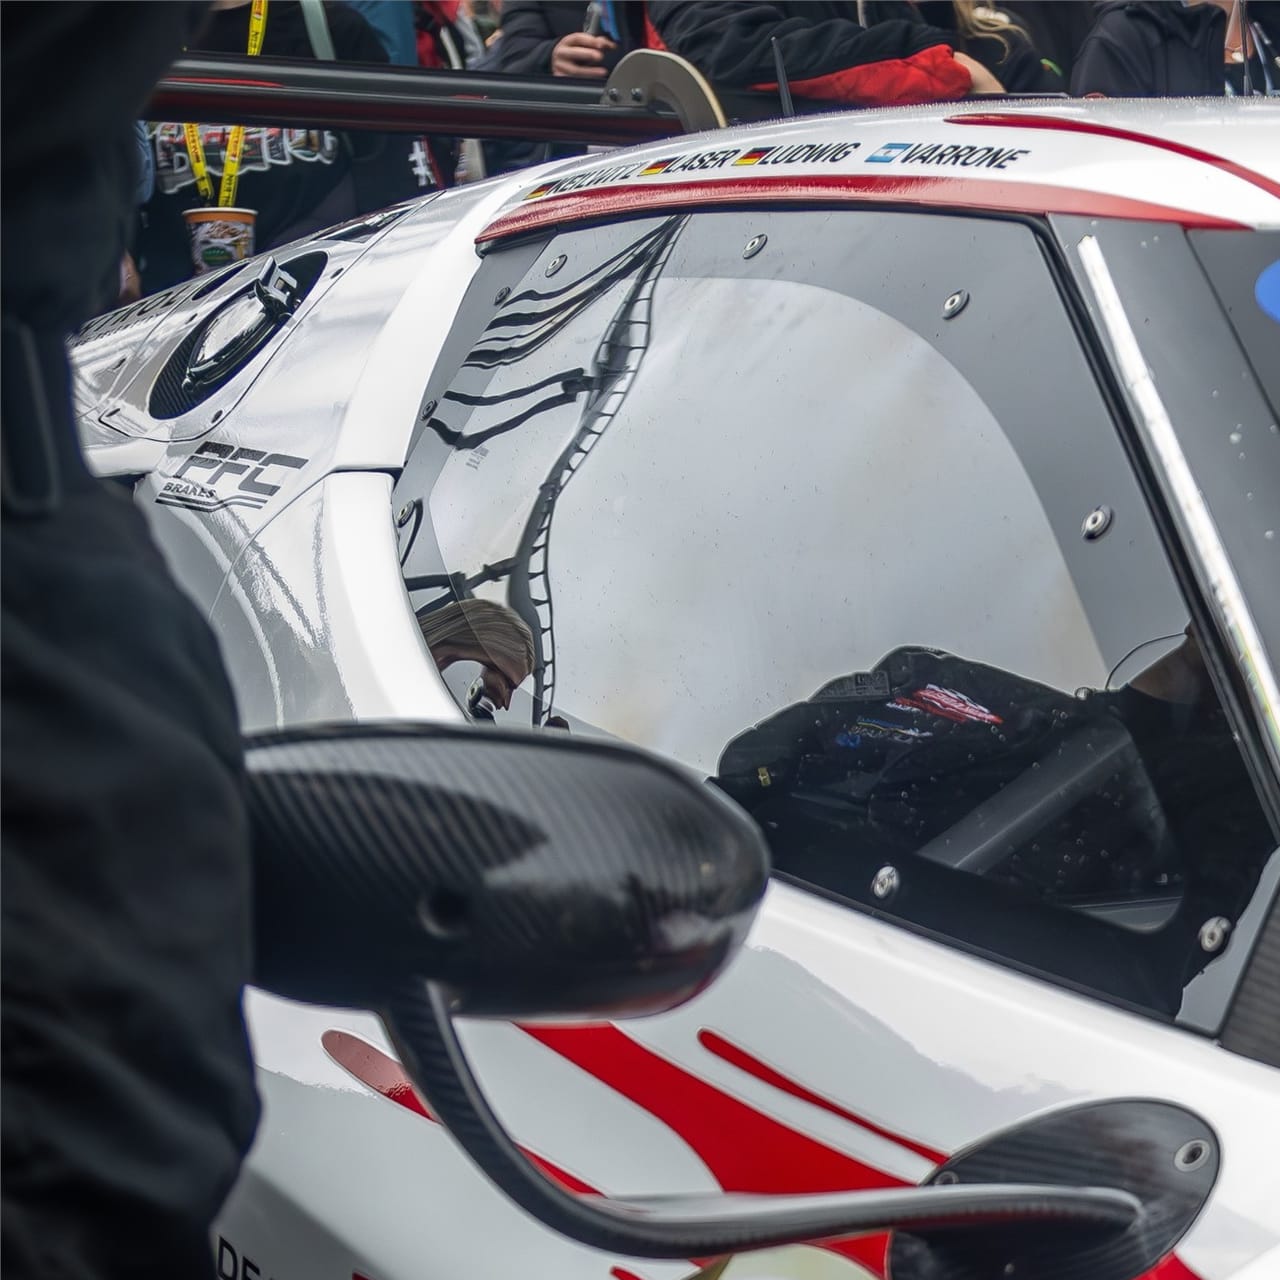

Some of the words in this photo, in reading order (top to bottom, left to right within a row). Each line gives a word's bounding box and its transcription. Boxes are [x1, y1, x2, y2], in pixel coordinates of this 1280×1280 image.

[661, 148, 741, 175] LASER
[759, 143, 861, 166] LUDWIG
[900, 143, 1032, 169] VARRONE
[173, 441, 310, 497] PFC
[163, 482, 217, 499] BRAKES
